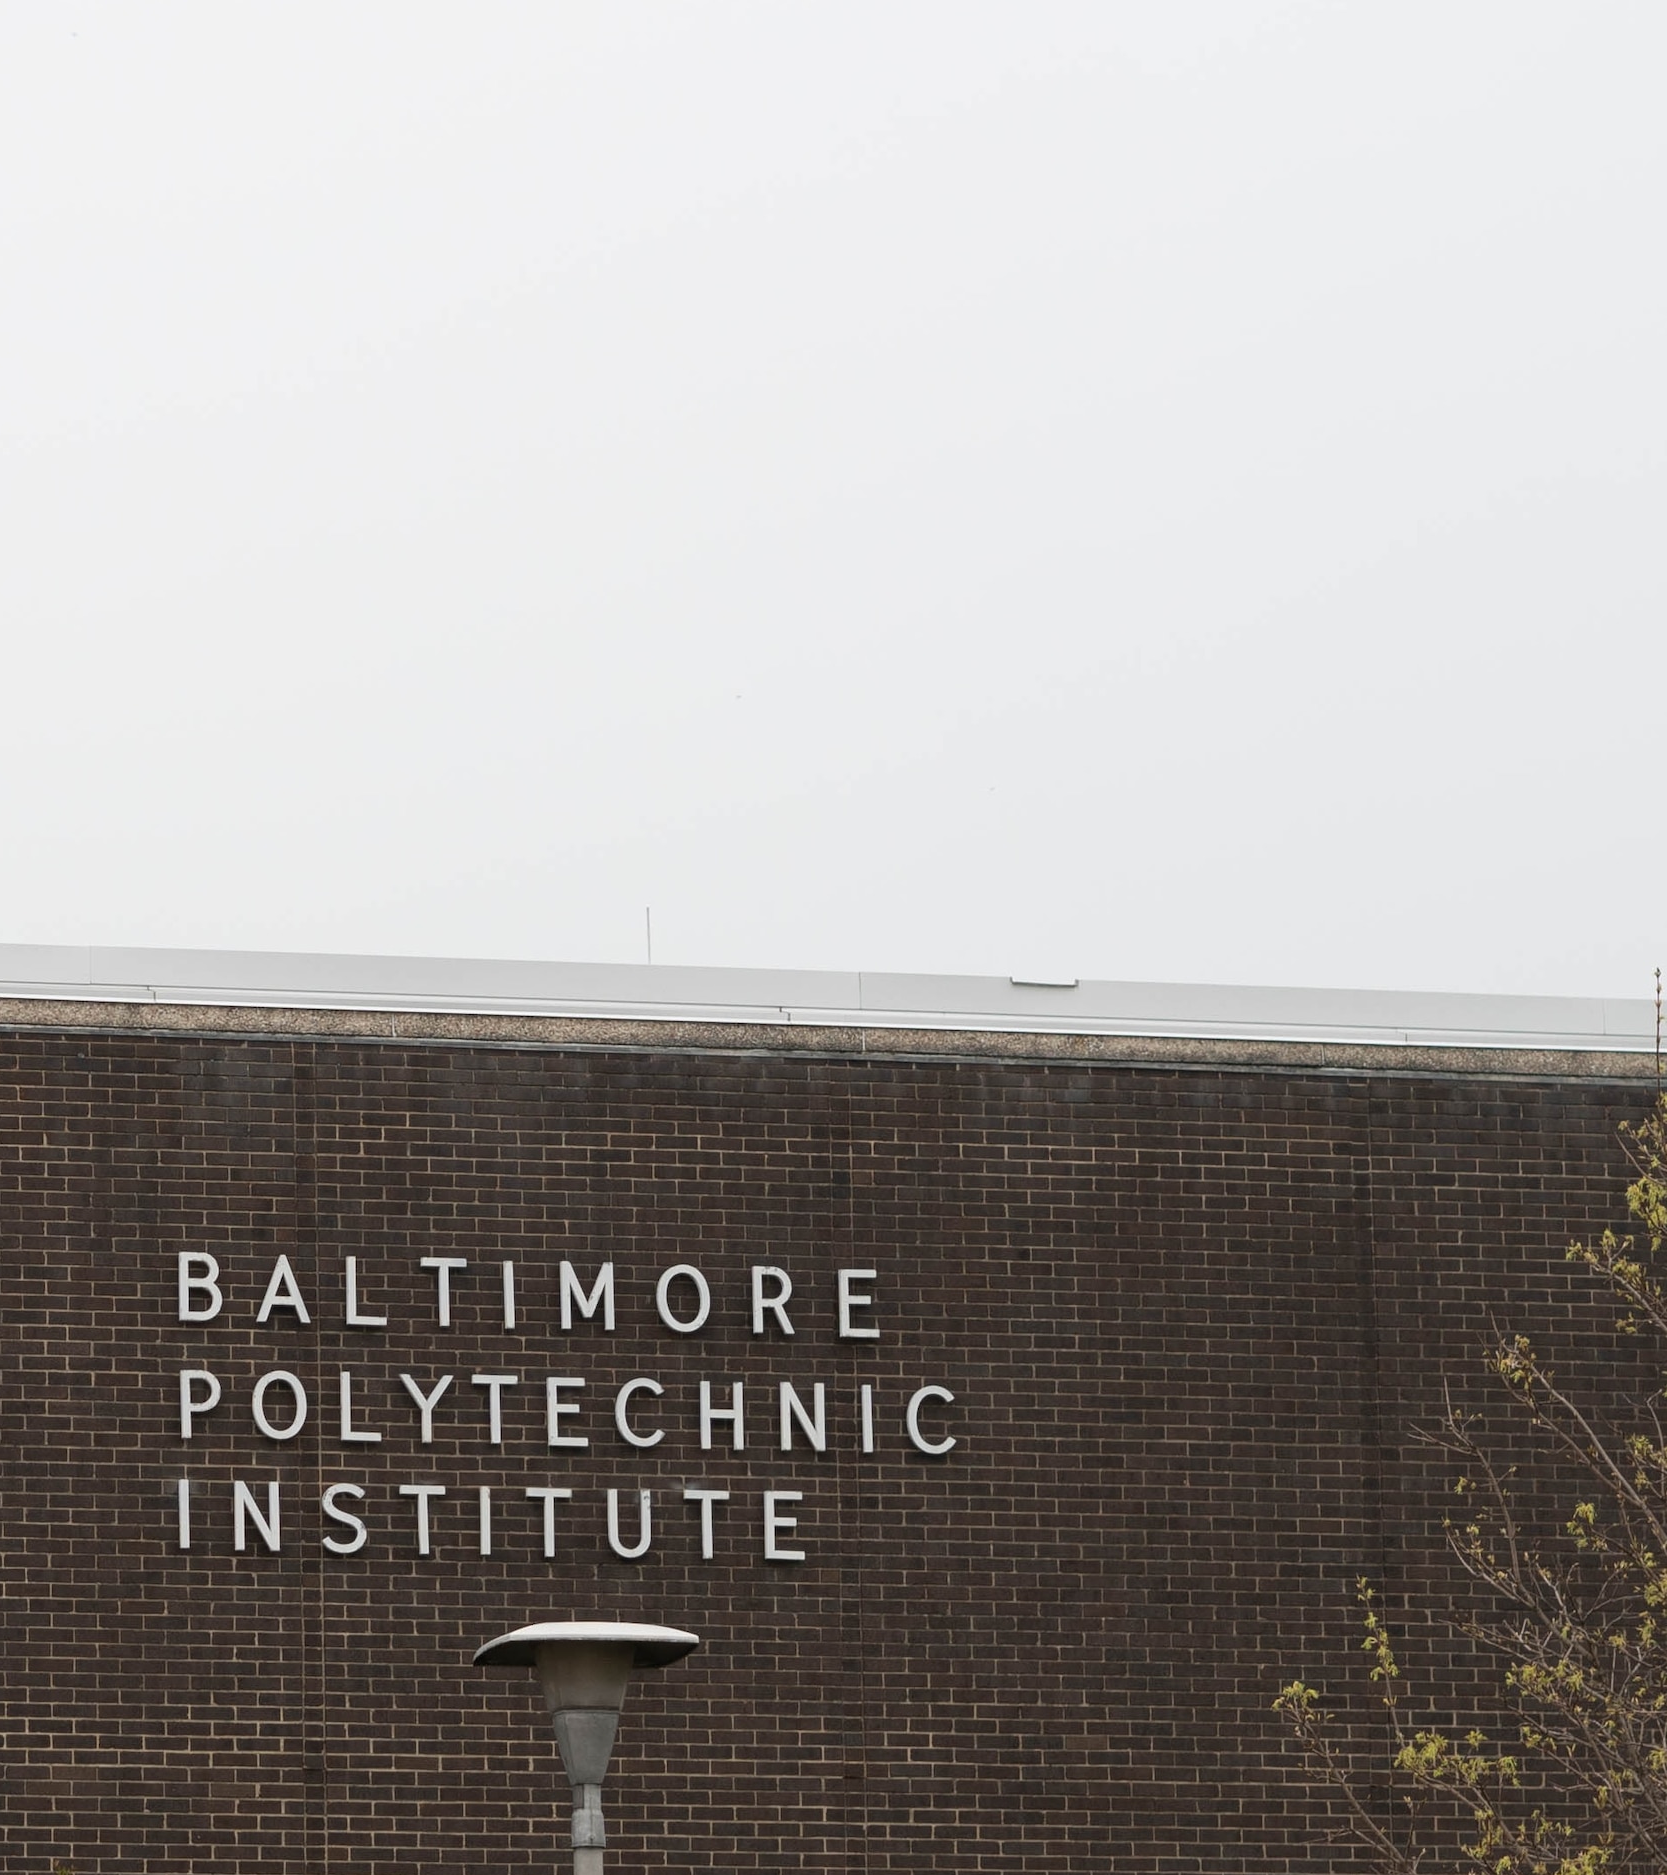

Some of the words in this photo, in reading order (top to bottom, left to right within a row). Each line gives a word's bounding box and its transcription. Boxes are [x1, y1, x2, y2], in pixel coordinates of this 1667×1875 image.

[178, 1251, 881, 1339] BALTIMORE
[179, 1369, 957, 1455] POLYTECHNIC
[178, 1478, 806, 1561] INSTITUTE
